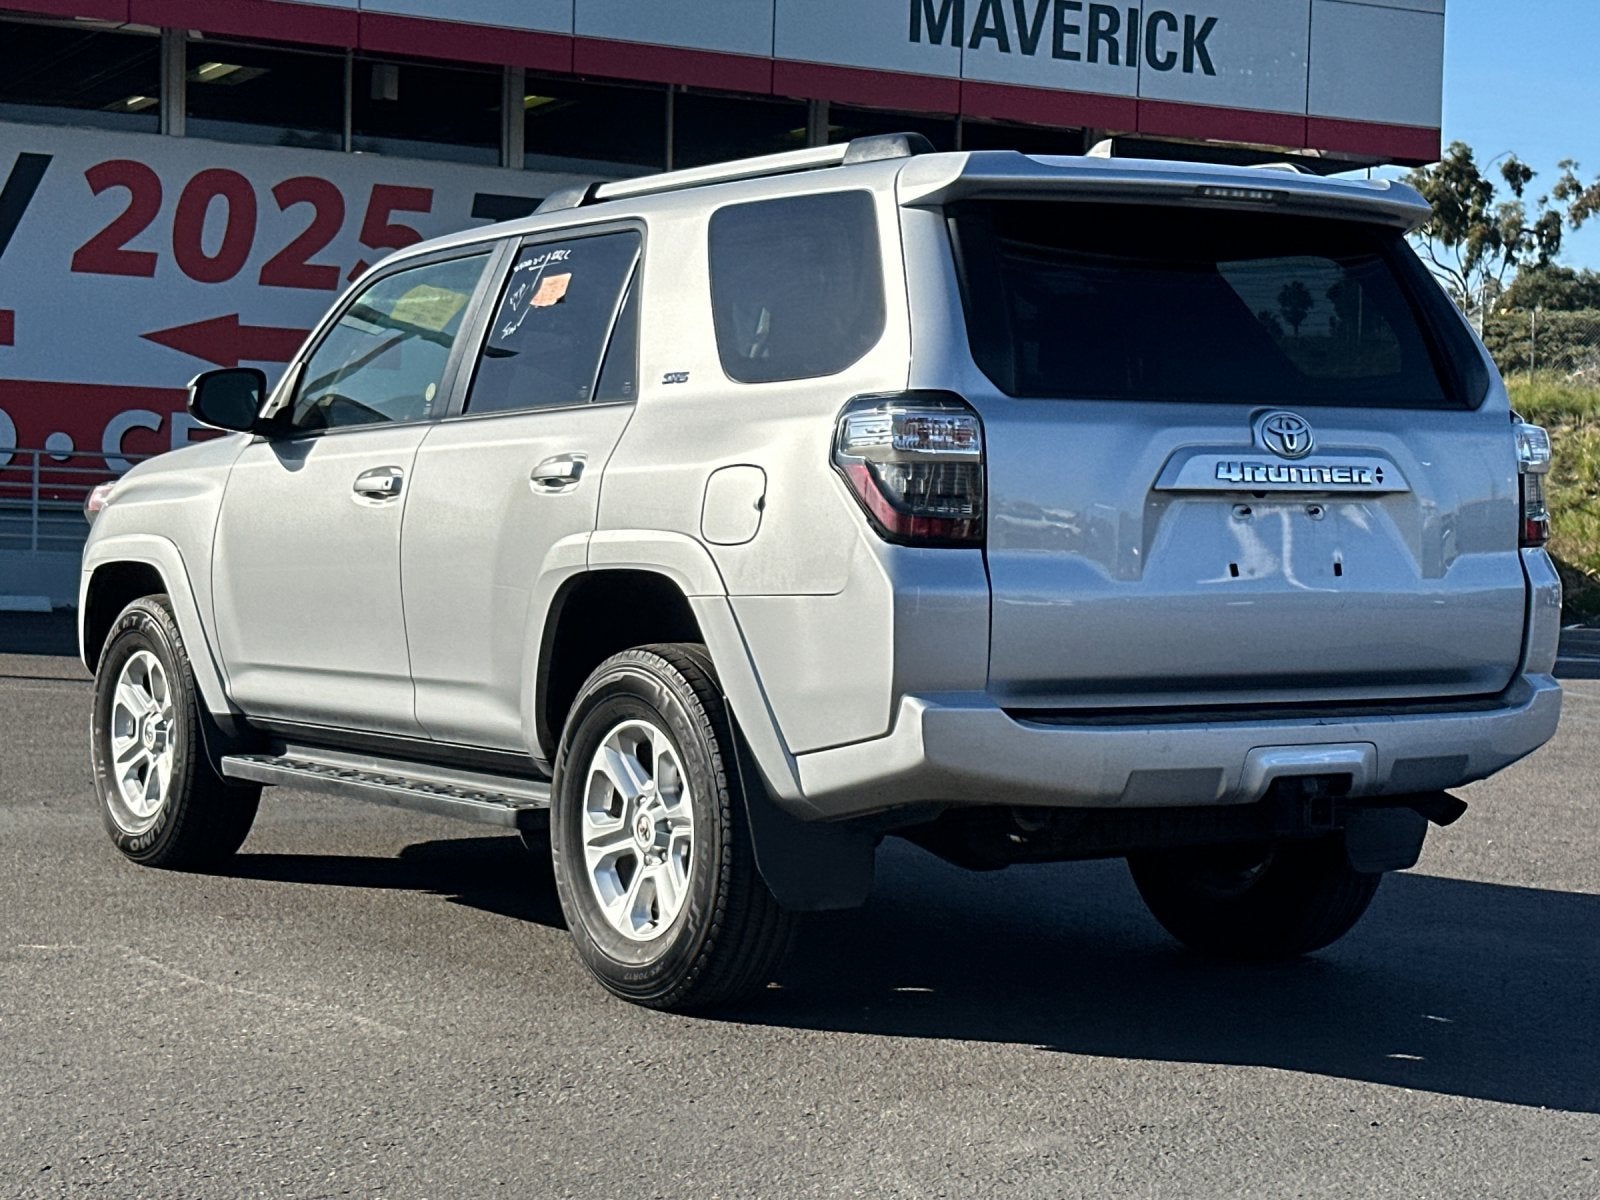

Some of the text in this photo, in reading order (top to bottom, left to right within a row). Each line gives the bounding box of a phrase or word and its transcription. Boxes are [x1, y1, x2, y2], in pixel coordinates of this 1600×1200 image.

[909, 0, 1218, 76] MAVERICK
[71, 159, 433, 290] 2025
[1216, 461, 1373, 485] 4RUNNER
